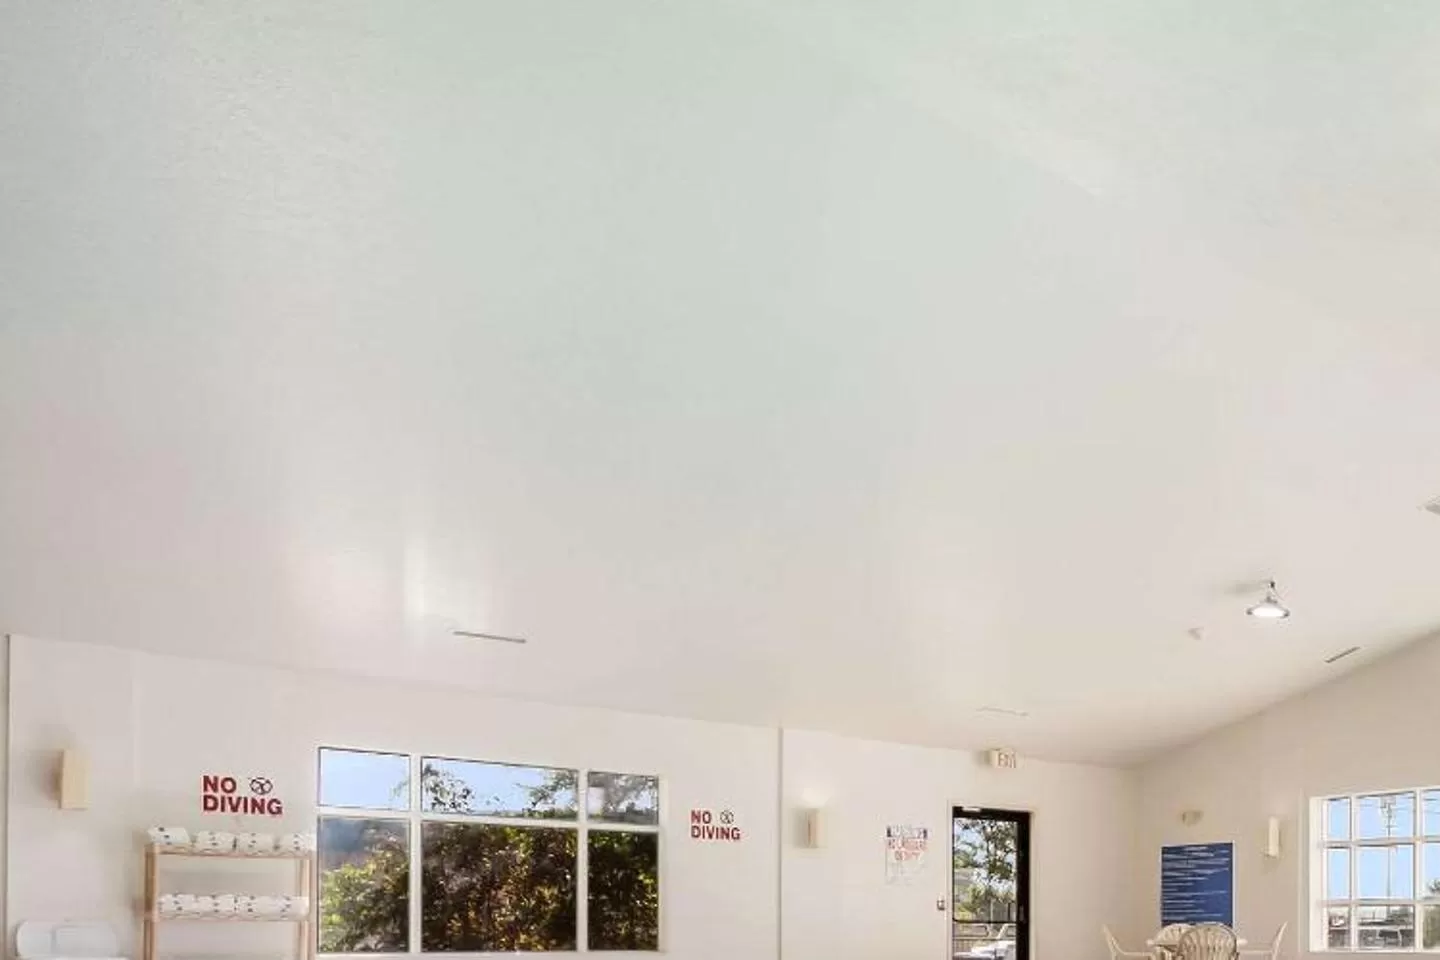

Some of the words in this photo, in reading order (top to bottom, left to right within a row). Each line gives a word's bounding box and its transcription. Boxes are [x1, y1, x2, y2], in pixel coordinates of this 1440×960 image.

[203, 775, 237, 794] NO
[203, 795, 283, 815] DIVING
[691, 810, 712, 824] NO
[691, 825, 741, 841] DIVING
